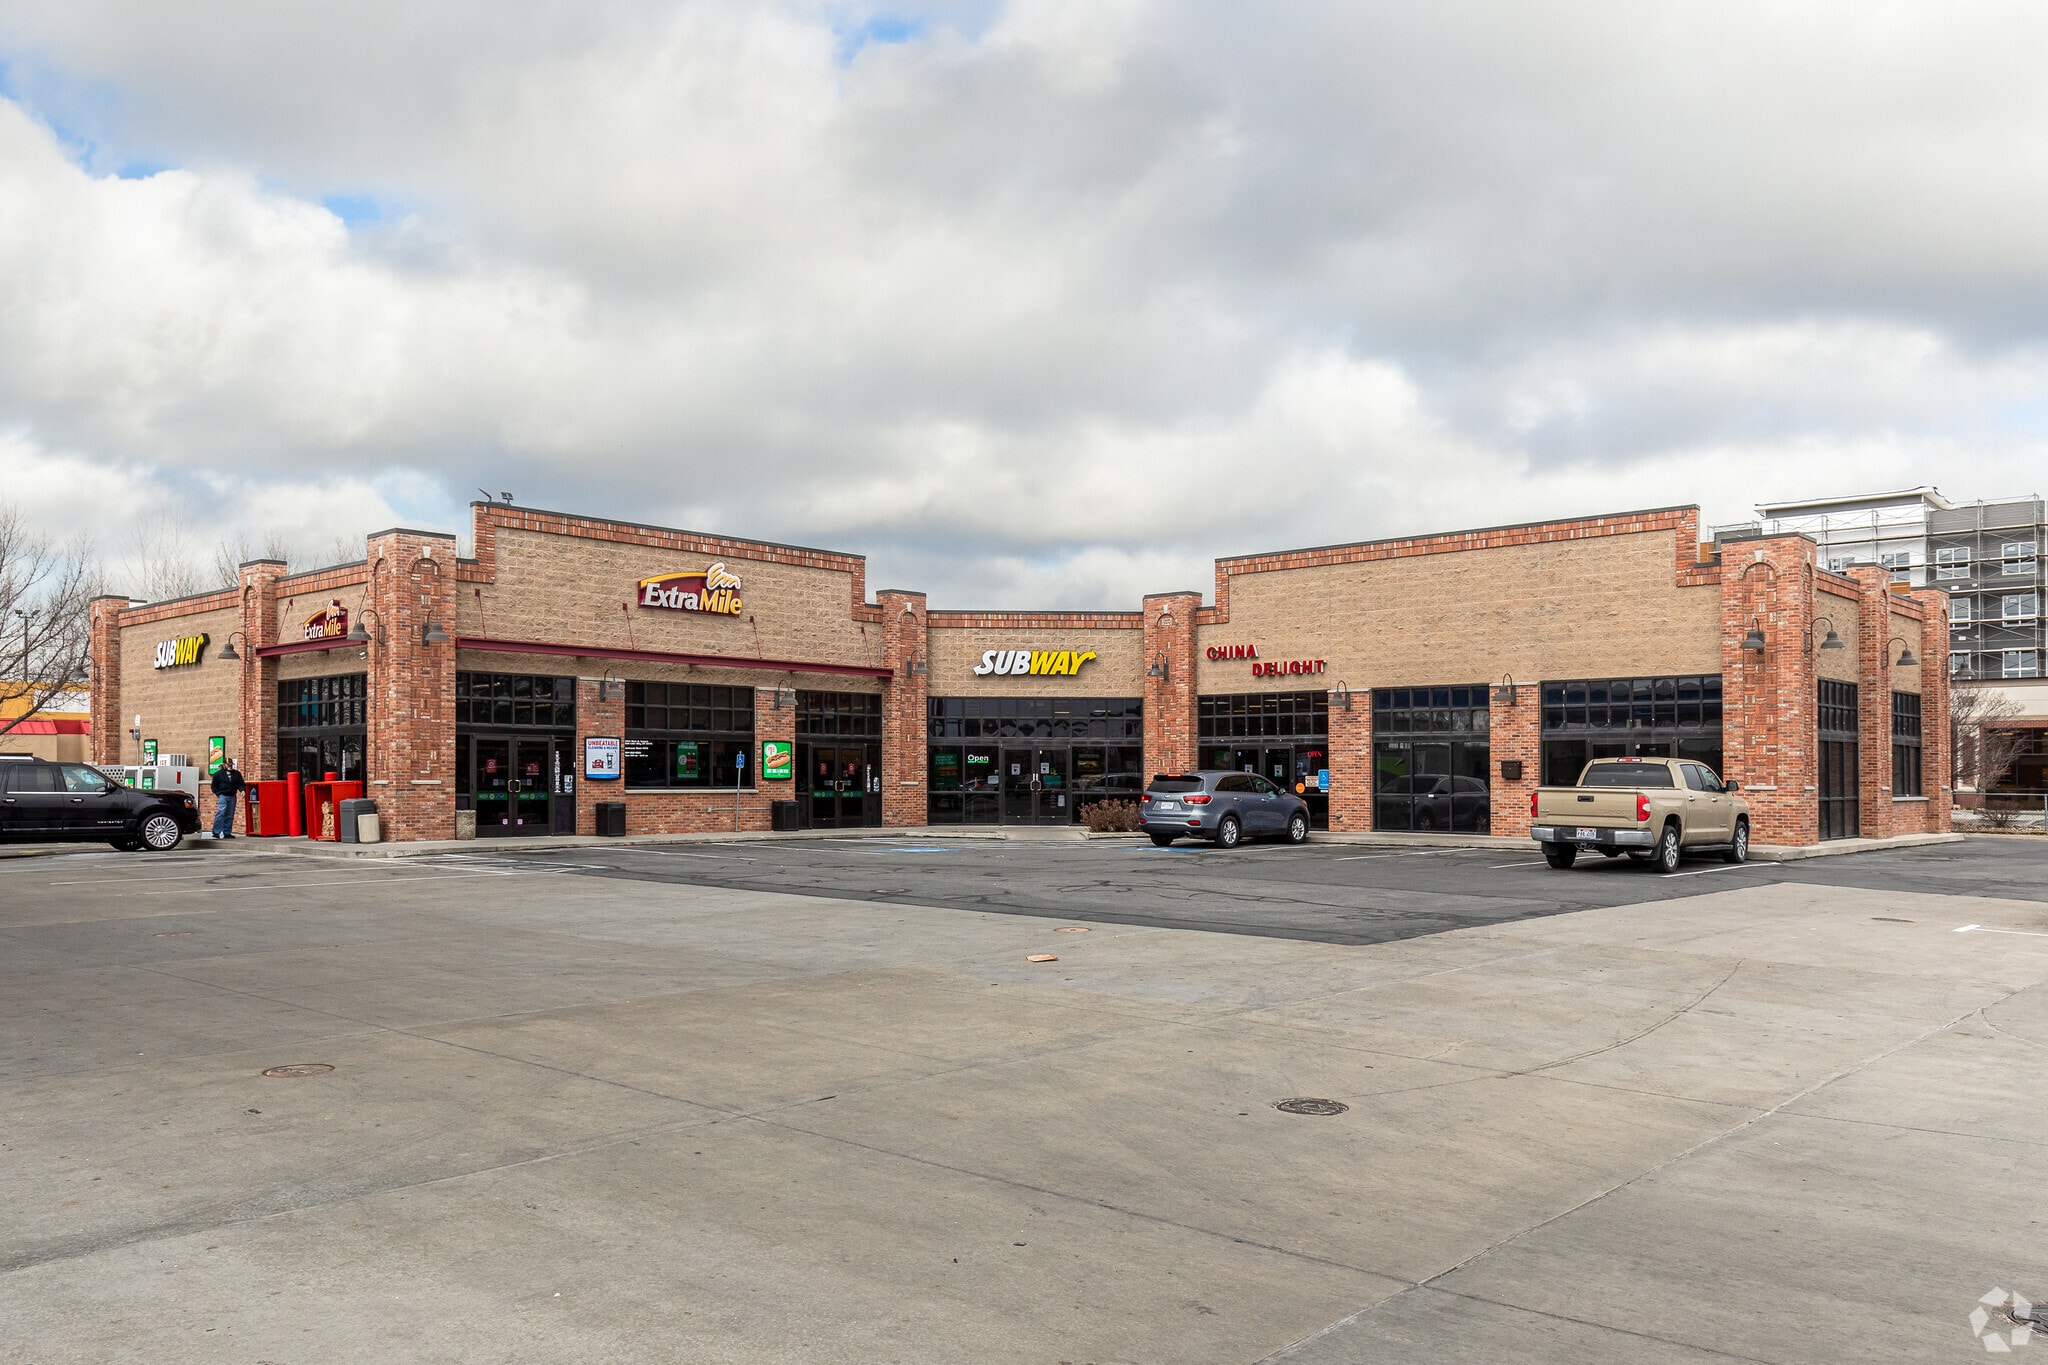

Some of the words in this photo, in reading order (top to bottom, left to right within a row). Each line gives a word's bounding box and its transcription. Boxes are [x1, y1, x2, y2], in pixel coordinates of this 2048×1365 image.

[153, 634, 206, 669] SUBWAY
[1206, 644, 1258, 660] CHINA
[972, 650, 1097, 676] SUBWAY
[1252, 660, 1327, 676] DELIGHT
[967, 754, 989, 764] Open
